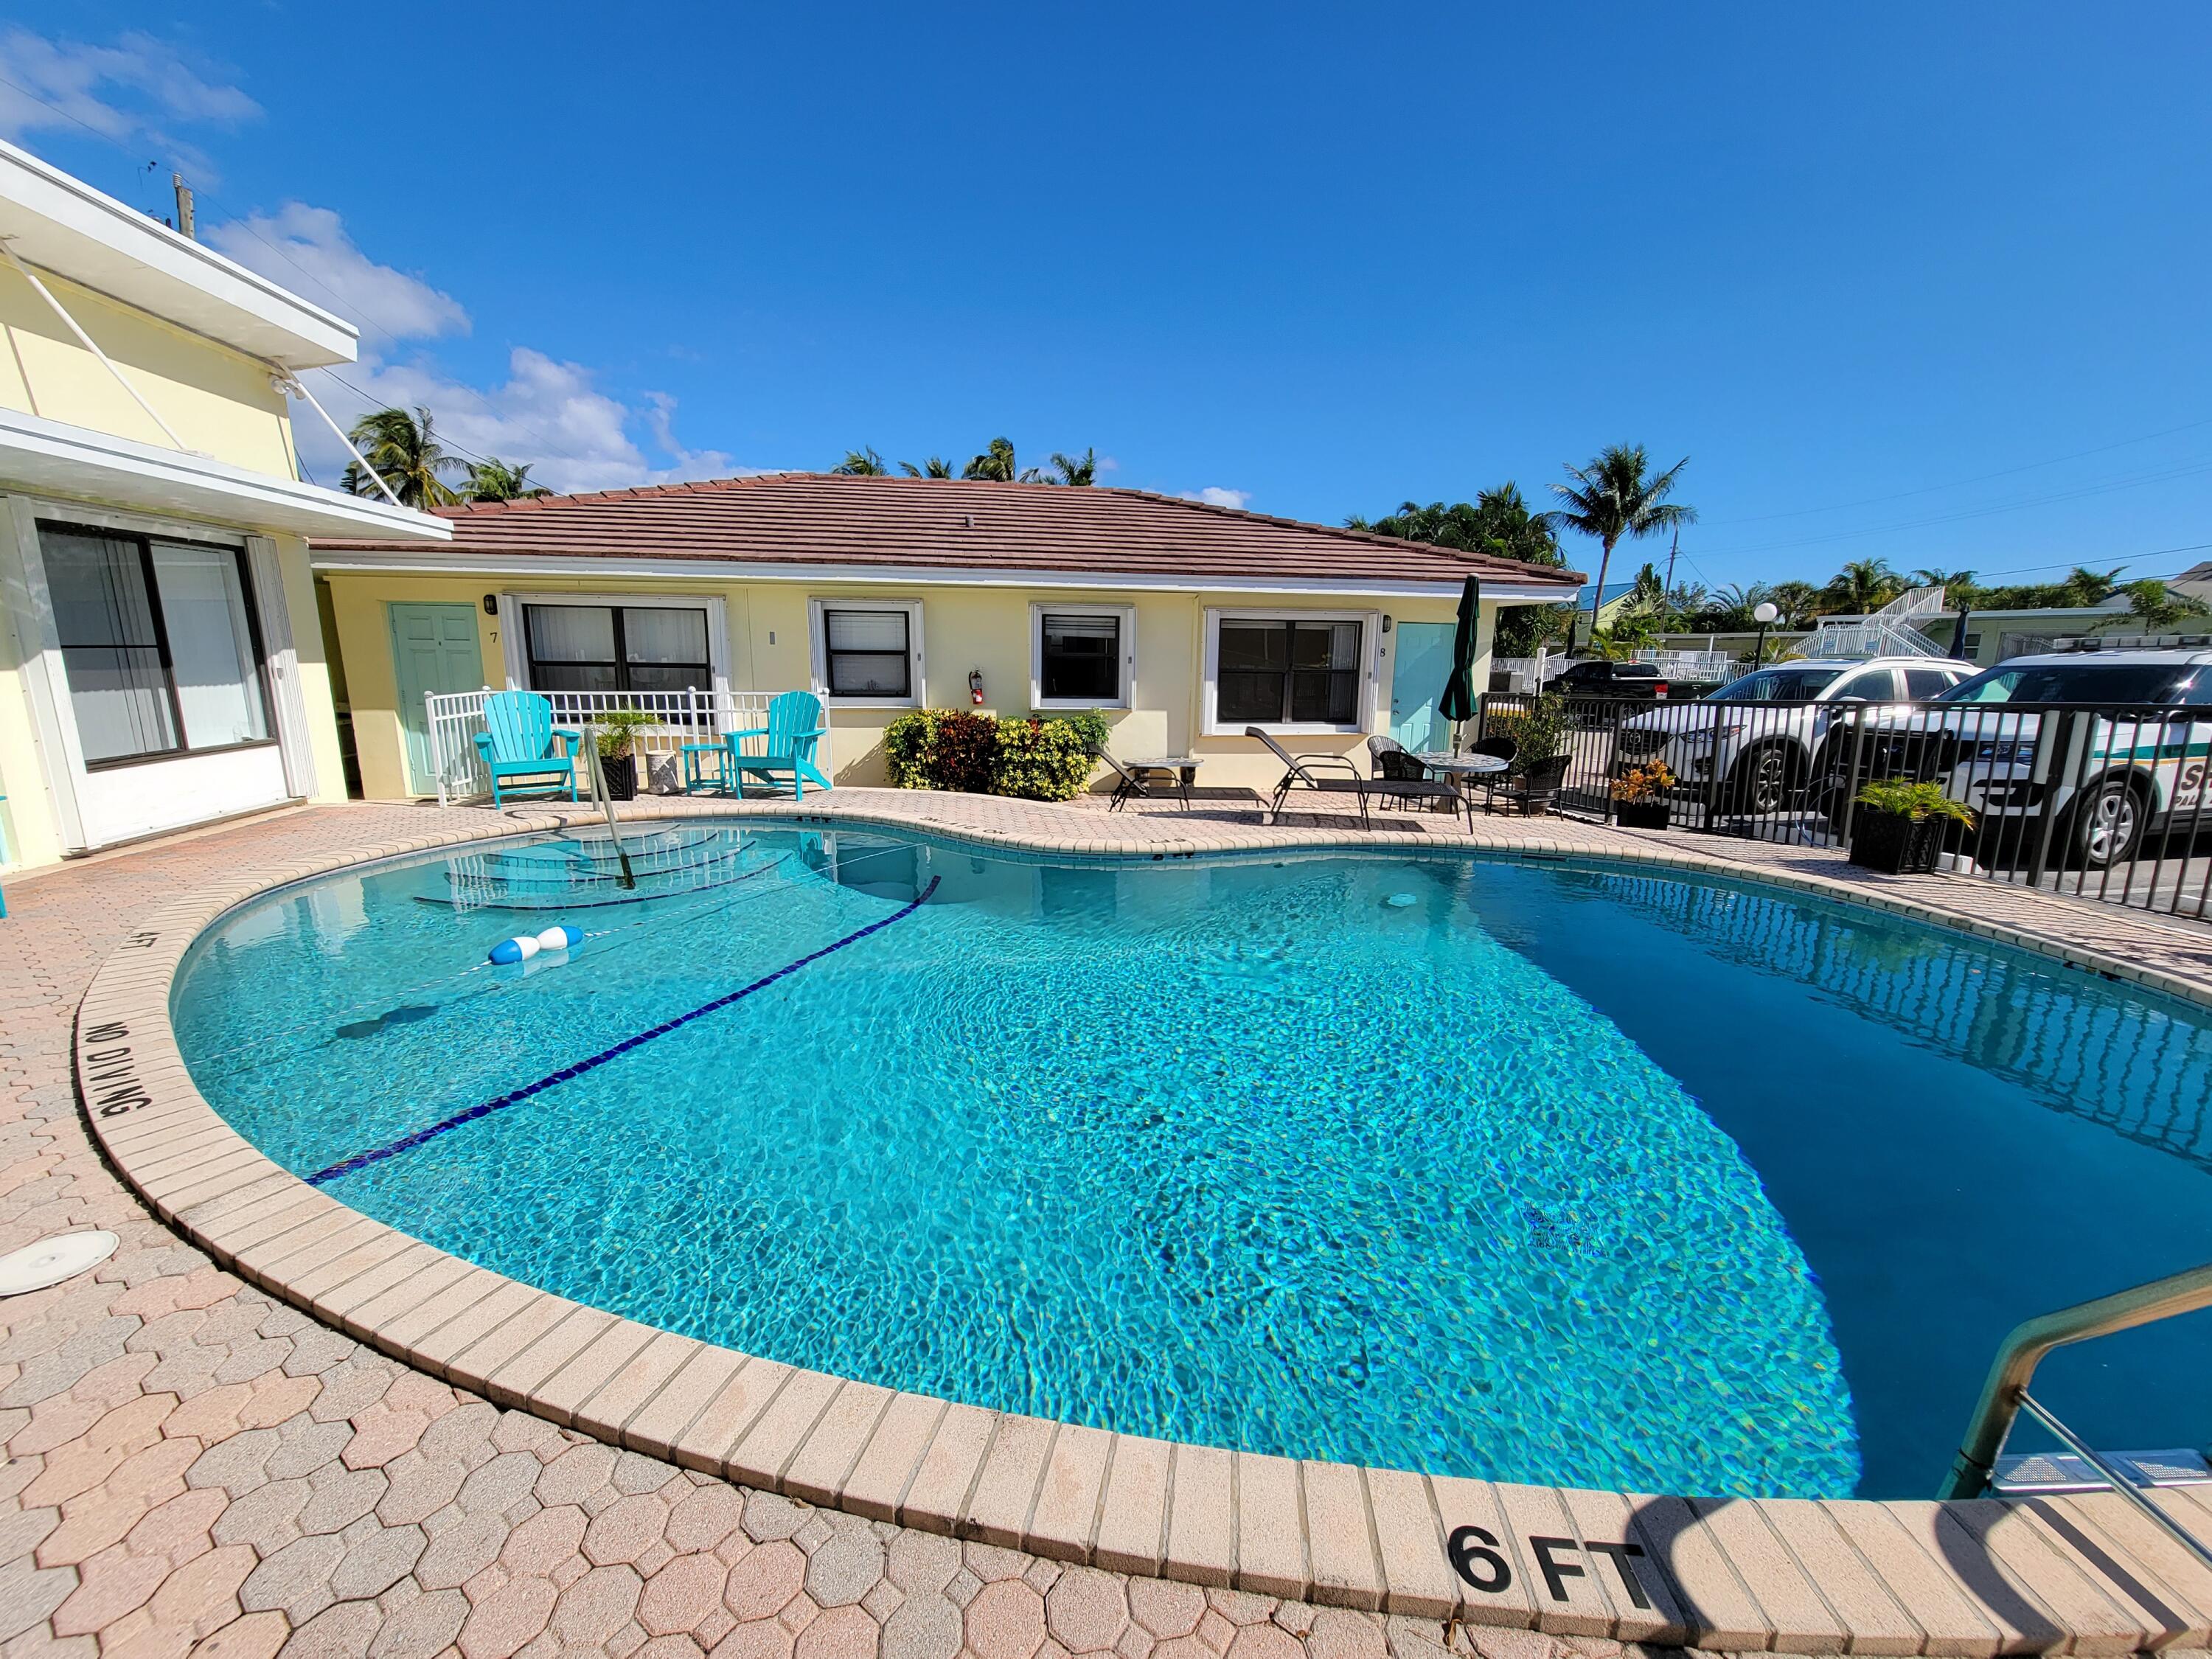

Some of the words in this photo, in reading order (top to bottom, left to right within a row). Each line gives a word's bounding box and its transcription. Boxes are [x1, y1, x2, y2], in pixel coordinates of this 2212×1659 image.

[490, 632, 497, 643] 7
[1380, 647, 1386, 657] 8
[119, 937, 158, 950] FT
[85, 1021, 130, 1043] NO
[86, 1047, 153, 1118] DIVING
[1447, 1525, 1512, 1593] 6
[1529, 1535, 1652, 1610] FT
